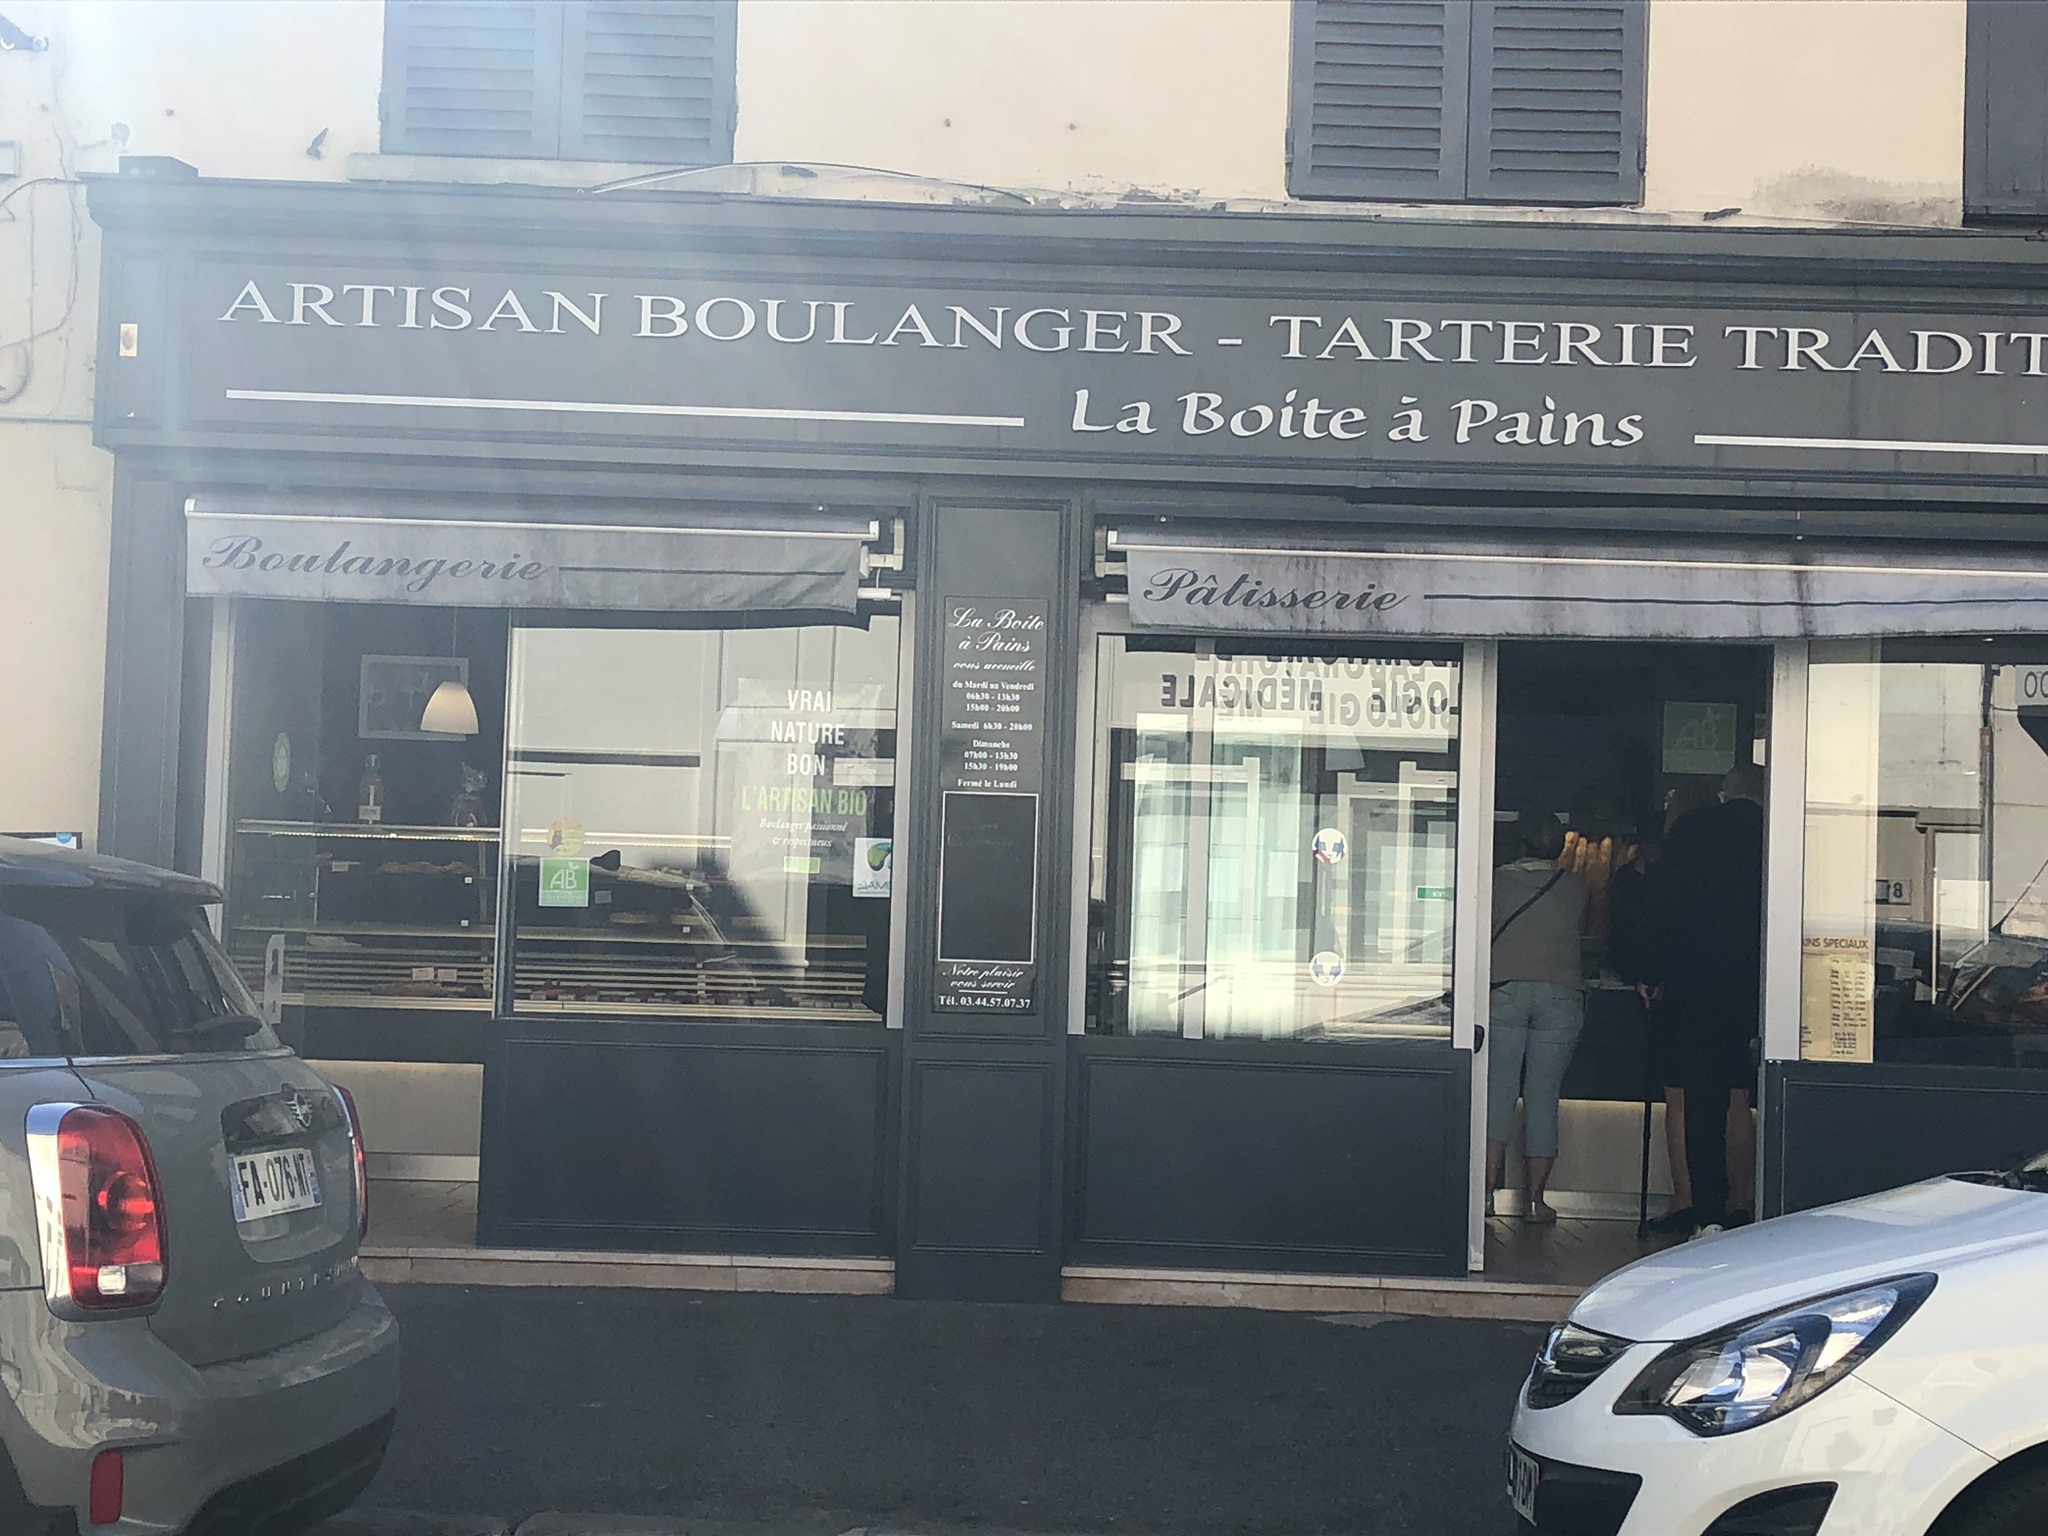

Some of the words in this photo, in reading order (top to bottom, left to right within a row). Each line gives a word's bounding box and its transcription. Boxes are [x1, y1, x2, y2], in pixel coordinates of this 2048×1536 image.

[217, 279, 608, 336] ARTISAN
[632, 294, 1194, 356] BOULANGER
[1268, 314, 1699, 369] TARTERIE
[1724, 325, 2048, 378] TRADIT
[1071, 388, 1159, 435] La
[1451, 395, 1644, 447] Pains
[202, 535, 553, 592] Boulangerie
[1143, 568, 1410, 611] Pâtisserie
[948, 607, 983, 629] La
[958, 635, 972, 650] à
[976, 631, 1031, 652] Pains
[953, 662, 980, 671] vous
[983, 660, 1036, 672] accueille
[952, 680, 963, 689] du
[964, 680, 988, 690] Mardi
[989, 682, 999, 690] au
[1001, 681, 1035, 691] Vendredi
[787, 689, 832, 712] VRAI
[771, 720, 846, 746] NATURE
[951, 721, 980, 730] Samedi
[973, 739, 1011, 749] Dimanche
[786, 753, 826, 776] BON
[957, 778, 983, 788] Fermé
[984, 779, 992, 788] le
[993, 780, 1018, 789] Lundi
[741, 785, 832, 815] L'ARTISAN
[837, 789, 868, 817] BIO
[759, 817, 804, 833] Boulanger
[804, 820, 848, 833] passionné
[549, 868, 578, 890] AB
[1823, 937, 1869, 949] SPECIAUX
[942, 963, 979, 977] Notre
[978, 965, 1024, 980] plaisir
[950, 980, 977, 988] vous
[981, 980, 1015, 989] servir
[939, 995, 958, 1006] Tél.
[960, 996, 1031, 1009] 03.44.57.07.37
